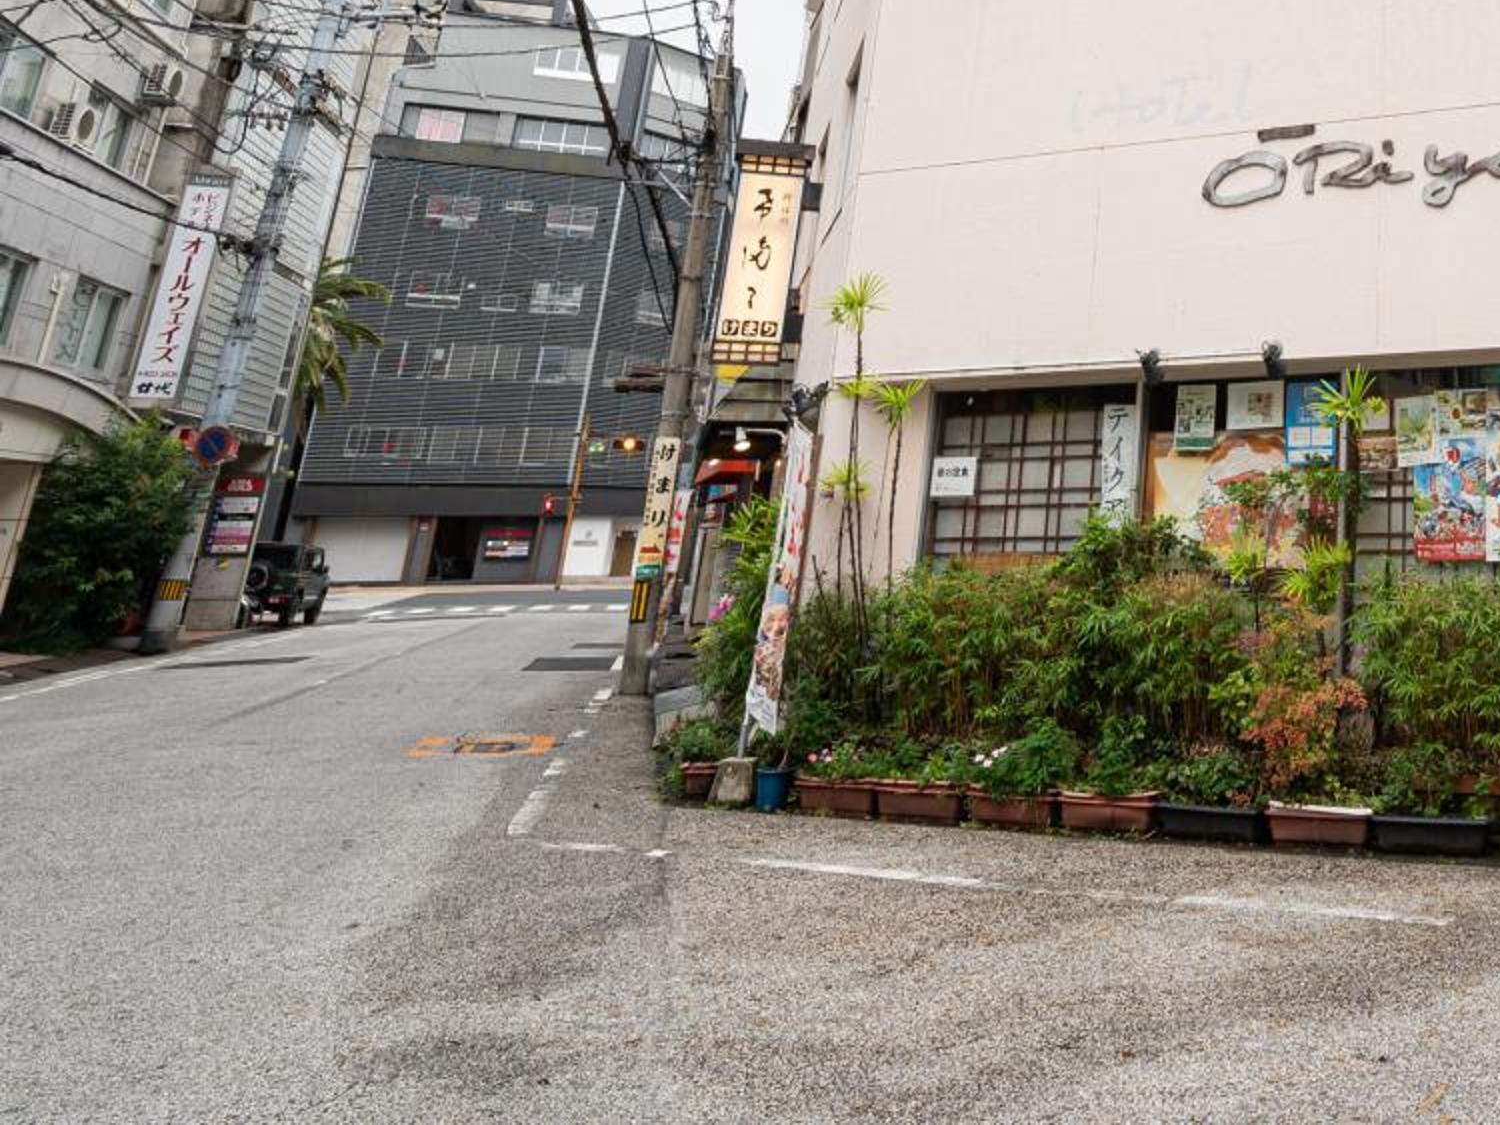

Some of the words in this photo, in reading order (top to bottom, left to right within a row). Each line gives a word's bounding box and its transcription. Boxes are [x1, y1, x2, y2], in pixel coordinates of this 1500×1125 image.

[151, 235, 205, 363] オールウェイズ
[722, 318, 778, 338] けまり
